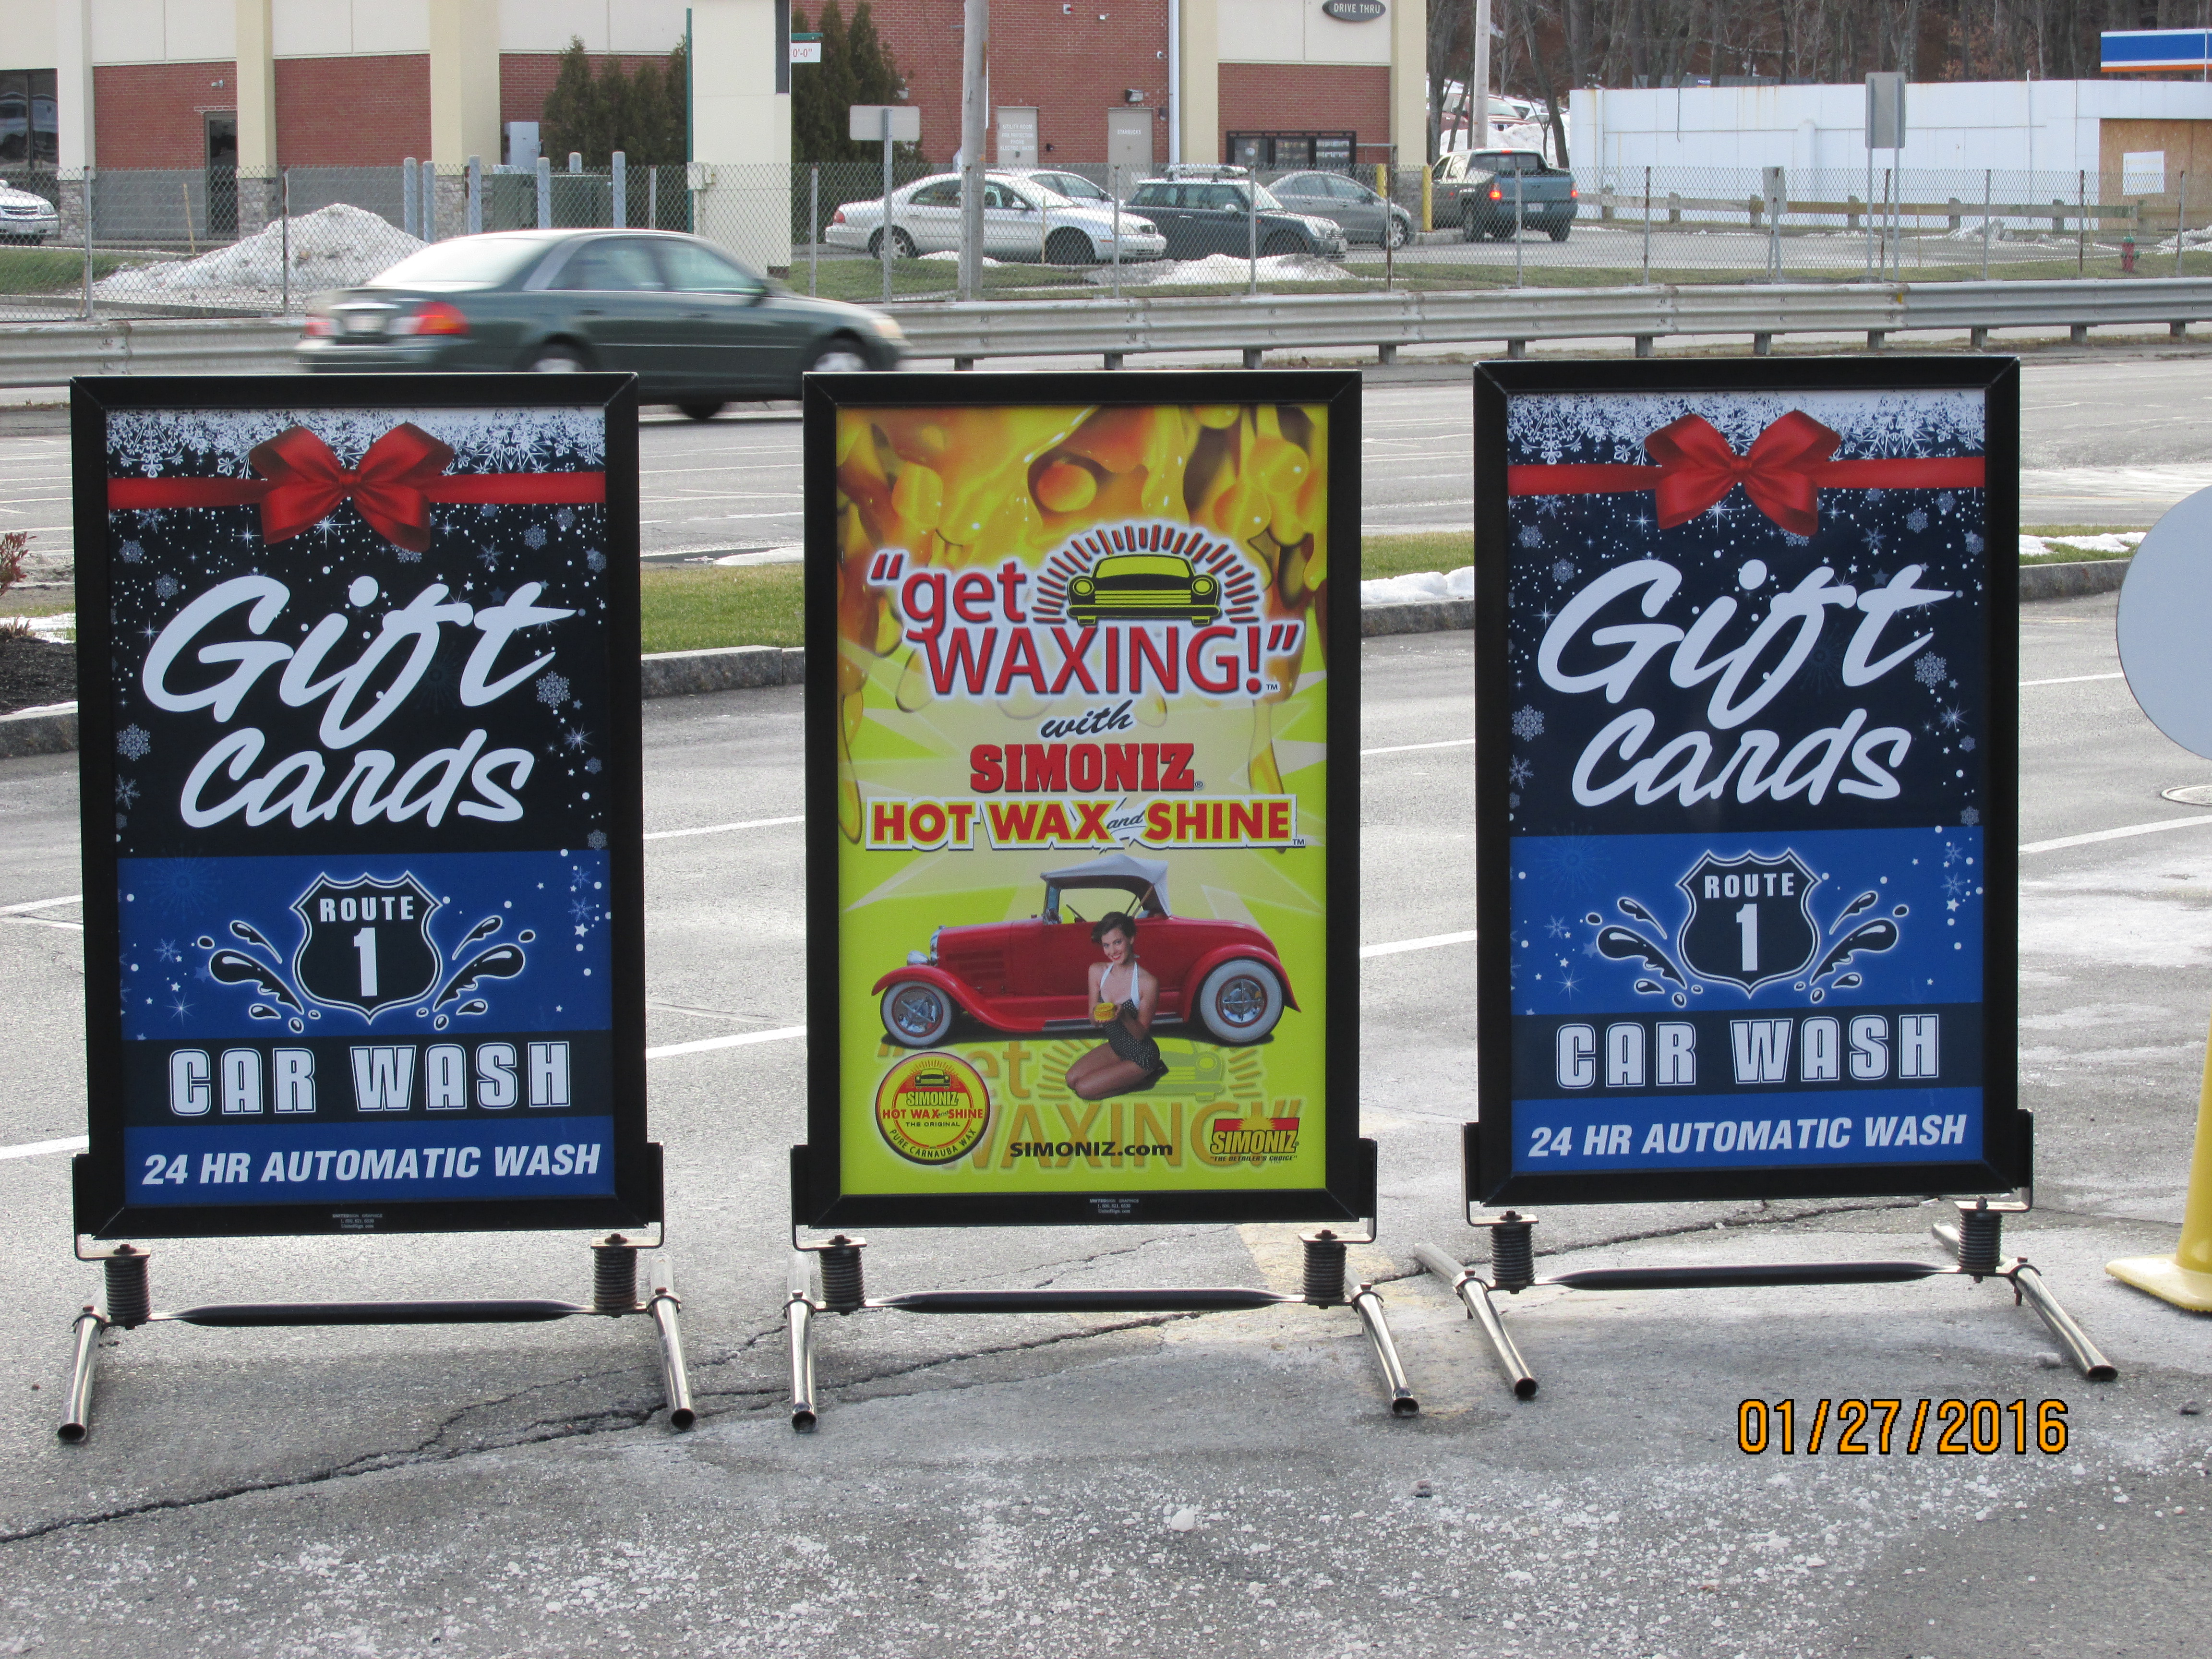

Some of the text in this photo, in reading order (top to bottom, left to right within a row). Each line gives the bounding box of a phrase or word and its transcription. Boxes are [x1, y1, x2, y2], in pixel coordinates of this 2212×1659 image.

[1334, 3, 1381, 13] DRIVE THRU
[143, 576, 576, 749] Gift
[1538, 559, 1955, 729] Gift
[1041, 699, 1134, 738] with
[180, 728, 534, 828] Cards
[970, 743, 1194, 793] SIMONIZ
[1572, 708, 1911, 806] Cards
[874, 804, 973, 842] HOT
[989, 804, 1111, 841] WAX
[1106, 810, 1146, 829] and
[1145, 802, 1289, 841] SHINE
[1705, 873, 1795, 899] ROUTE
[319, 896, 414, 922] ROUTE
[1736, 903, 1757, 971] 1
[353, 927, 377, 997] 1
[1556, 1014, 1939, 1089] CAR WASH
[169, 1041, 570, 1116] CAR WASH
[906, 1091, 958, 1106] SIMONIZ
[882, 1109, 907, 1119] HOT
[911, 1109, 939, 1119] WAX
[948, 1108, 983, 1119] SHINE
[890, 1128, 976, 1158] PURE CARNAUBA WAX
[1010, 1141, 1173, 1158] SIMONIZ.com
[1210, 1130, 1298, 1154] SIMONIZ
[1528, 1114, 1967, 1157] 24 HR AUTOMATIC WASH
[142, 1143, 601, 1185] 24 HR AUTOMATIC WASH
